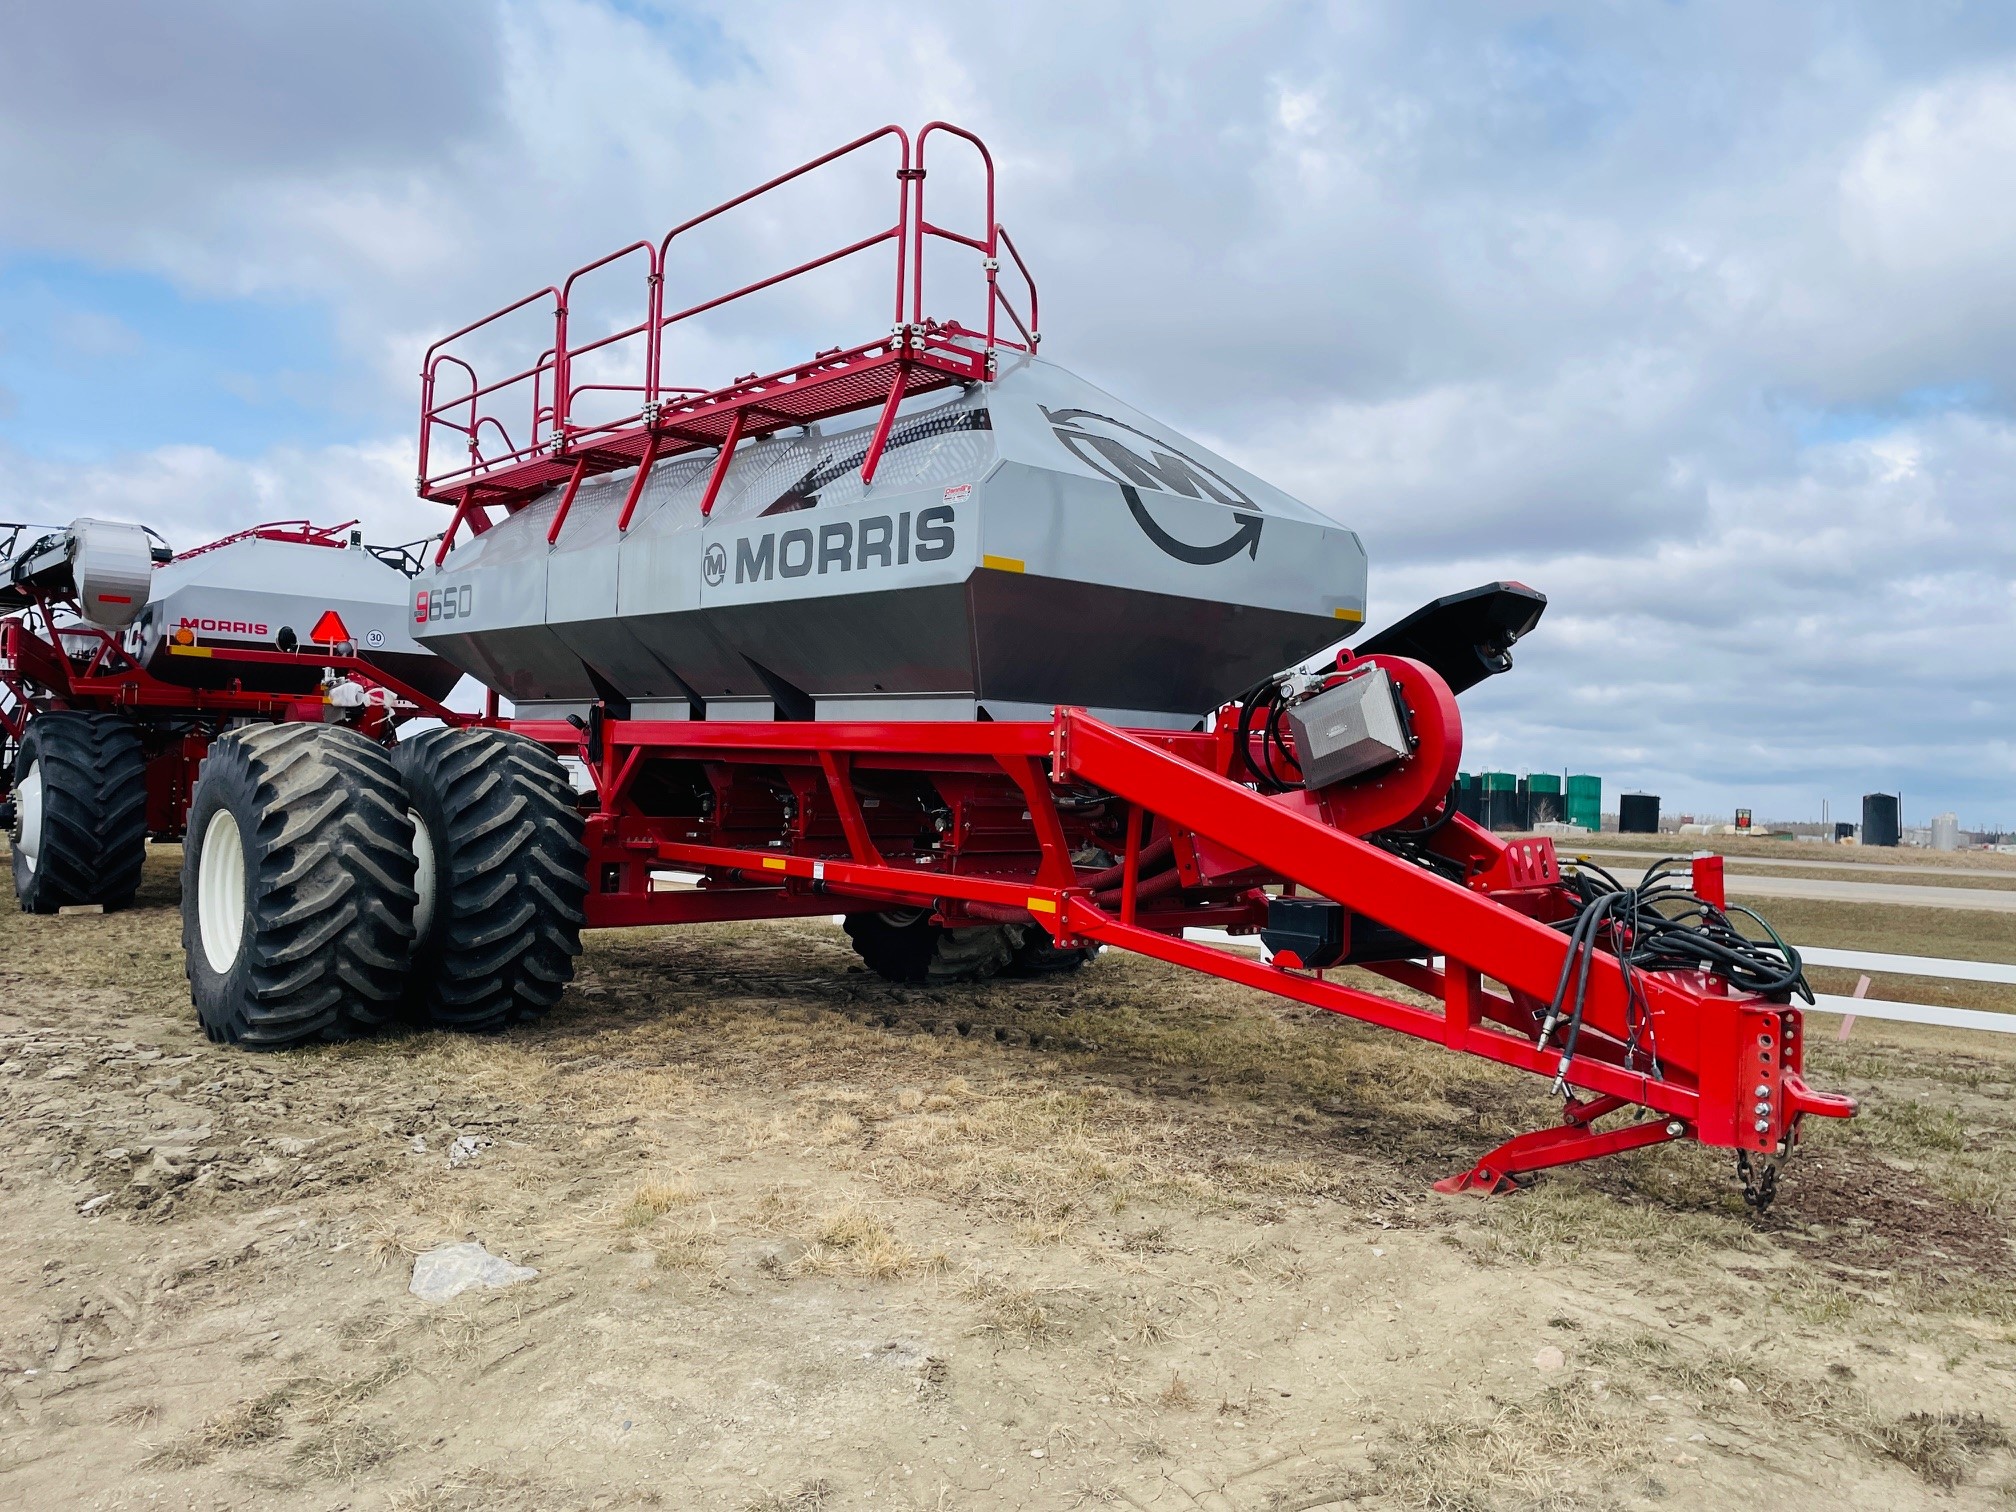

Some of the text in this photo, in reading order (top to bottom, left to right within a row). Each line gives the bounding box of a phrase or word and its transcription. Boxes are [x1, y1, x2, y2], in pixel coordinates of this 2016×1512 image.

[734, 505, 955, 584] MORRIS
[415, 584, 472, 623] 9650
[180, 617, 268, 635] MORRIS
[370, 633, 382, 642] 30
